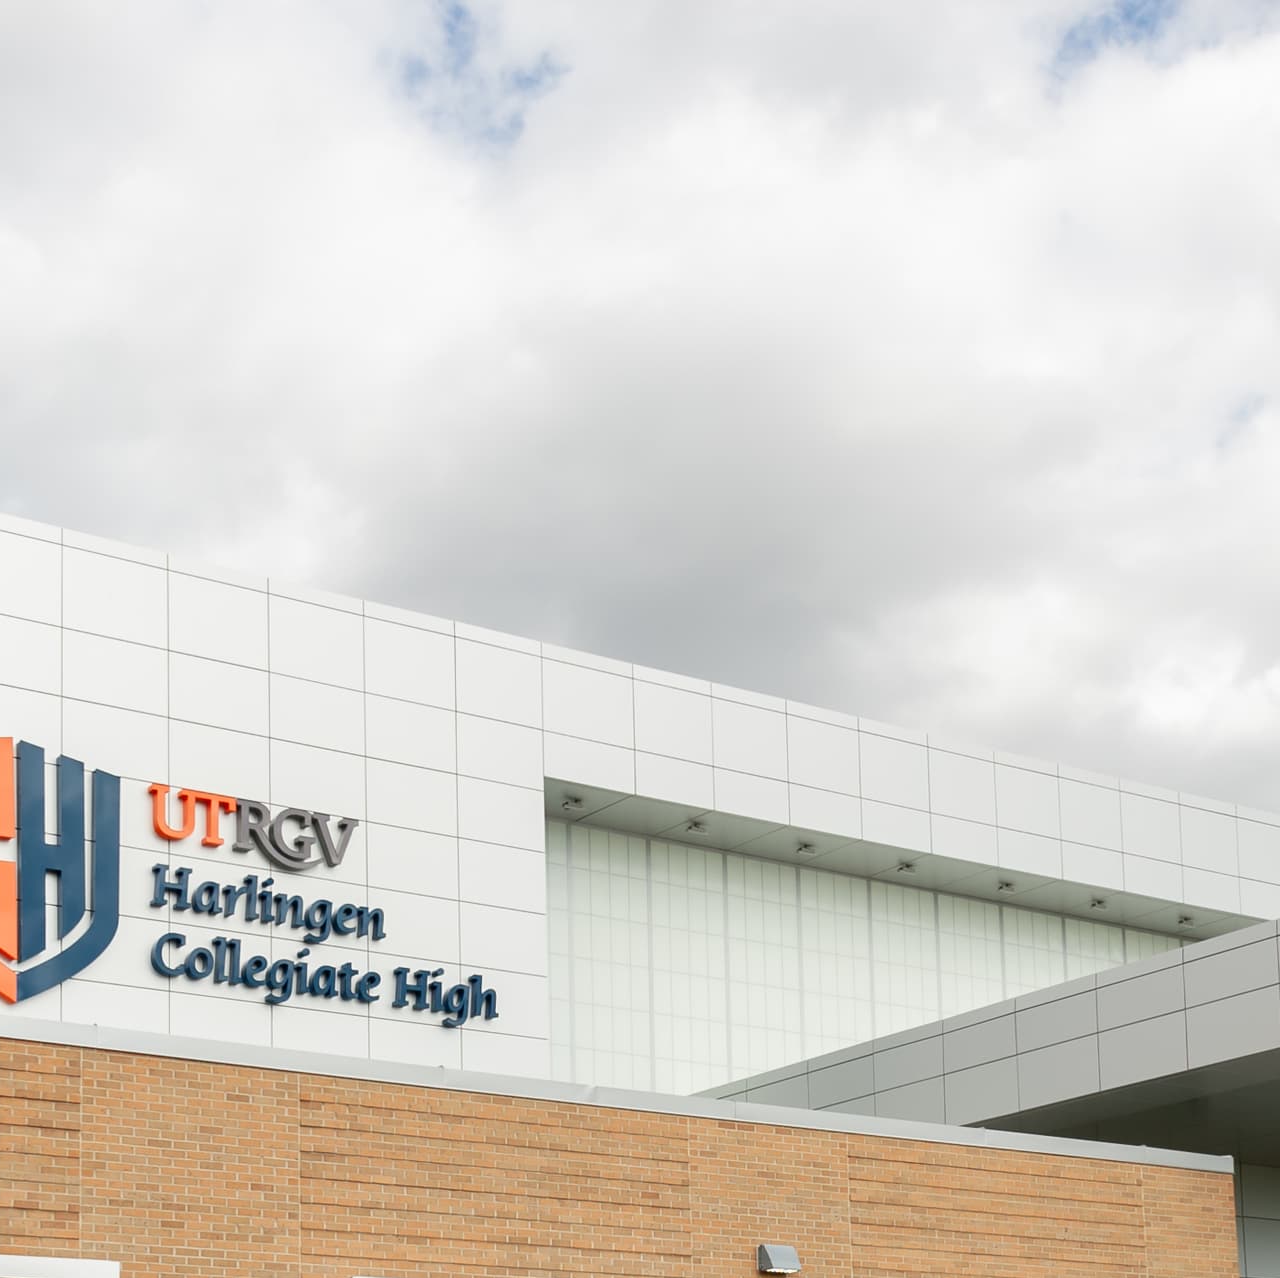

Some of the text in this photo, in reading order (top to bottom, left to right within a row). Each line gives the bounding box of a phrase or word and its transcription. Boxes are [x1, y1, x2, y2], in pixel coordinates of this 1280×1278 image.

[147, 782, 360, 872] UTRGV
[149, 863, 387, 944] Harlingen
[150, 931, 499, 1029] Collegiate High
